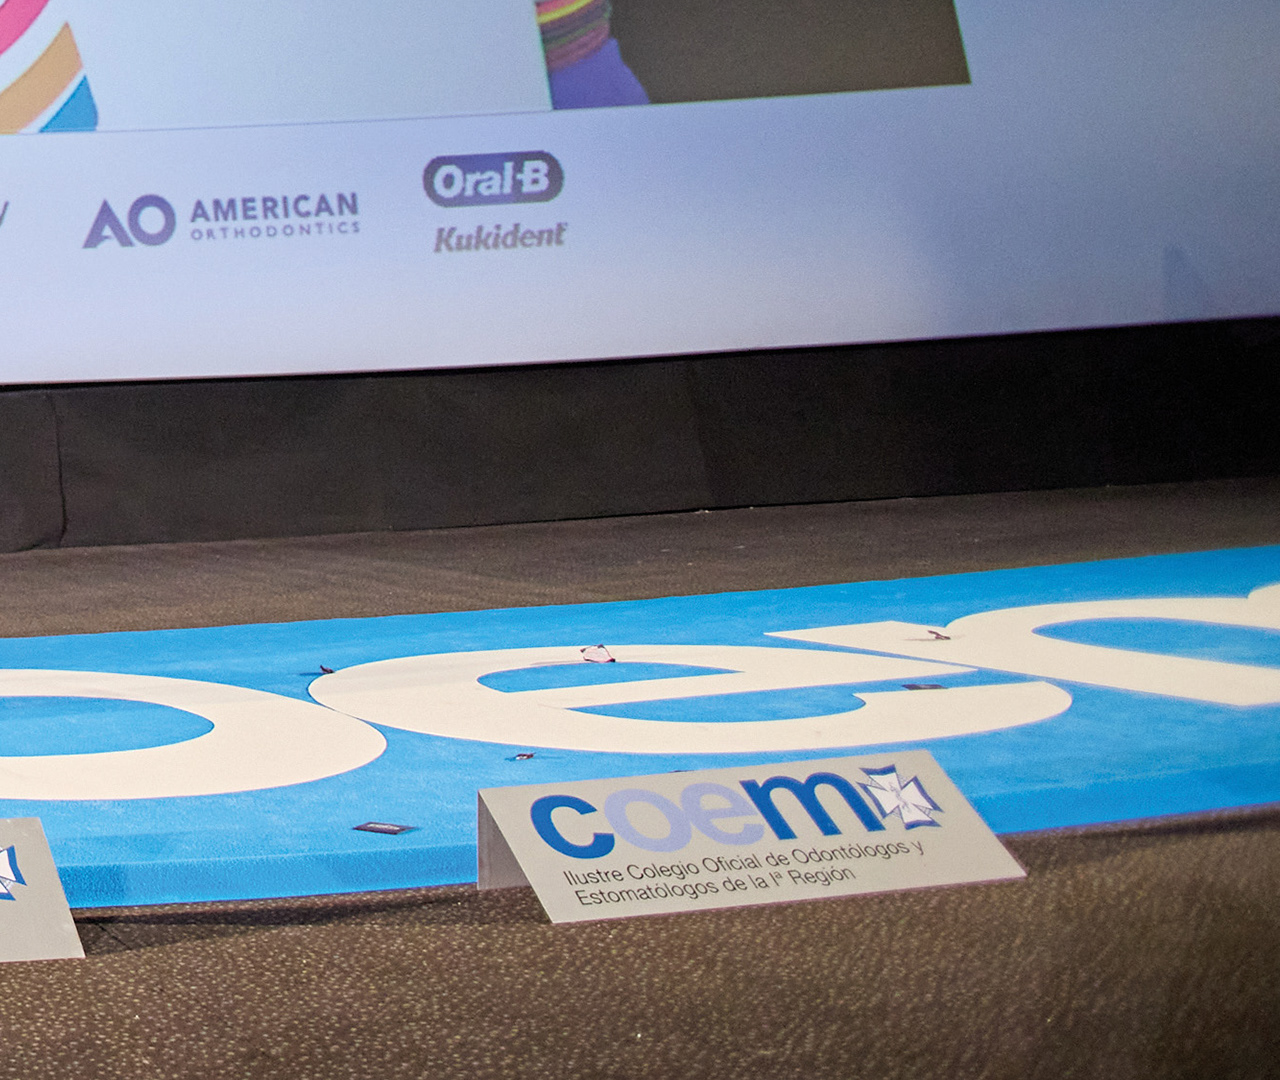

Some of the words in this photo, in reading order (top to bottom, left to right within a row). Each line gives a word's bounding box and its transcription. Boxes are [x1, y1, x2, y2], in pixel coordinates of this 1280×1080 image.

[434, 156, 550, 200] Oral-B
[190, 192, 360, 223] AMERICAN
[191, 221, 361, 241] ORTHODONTICS
[434, 221, 568, 254] Kukident
[530, 771, 887, 860] coem
[563, 868, 624, 887] Ilustre
[626, 861, 700, 881] Colegio
[702, 853, 762, 874] Oficial
[765, 852, 791, 867] de
[791, 841, 910, 865] Odontólogos
[911, 840, 925, 856] y
[575, 880, 719, 906] Estomatólogos
[722, 877, 747, 892] de
[748, 874, 770, 889] la
[787, 865, 857, 886] Región
